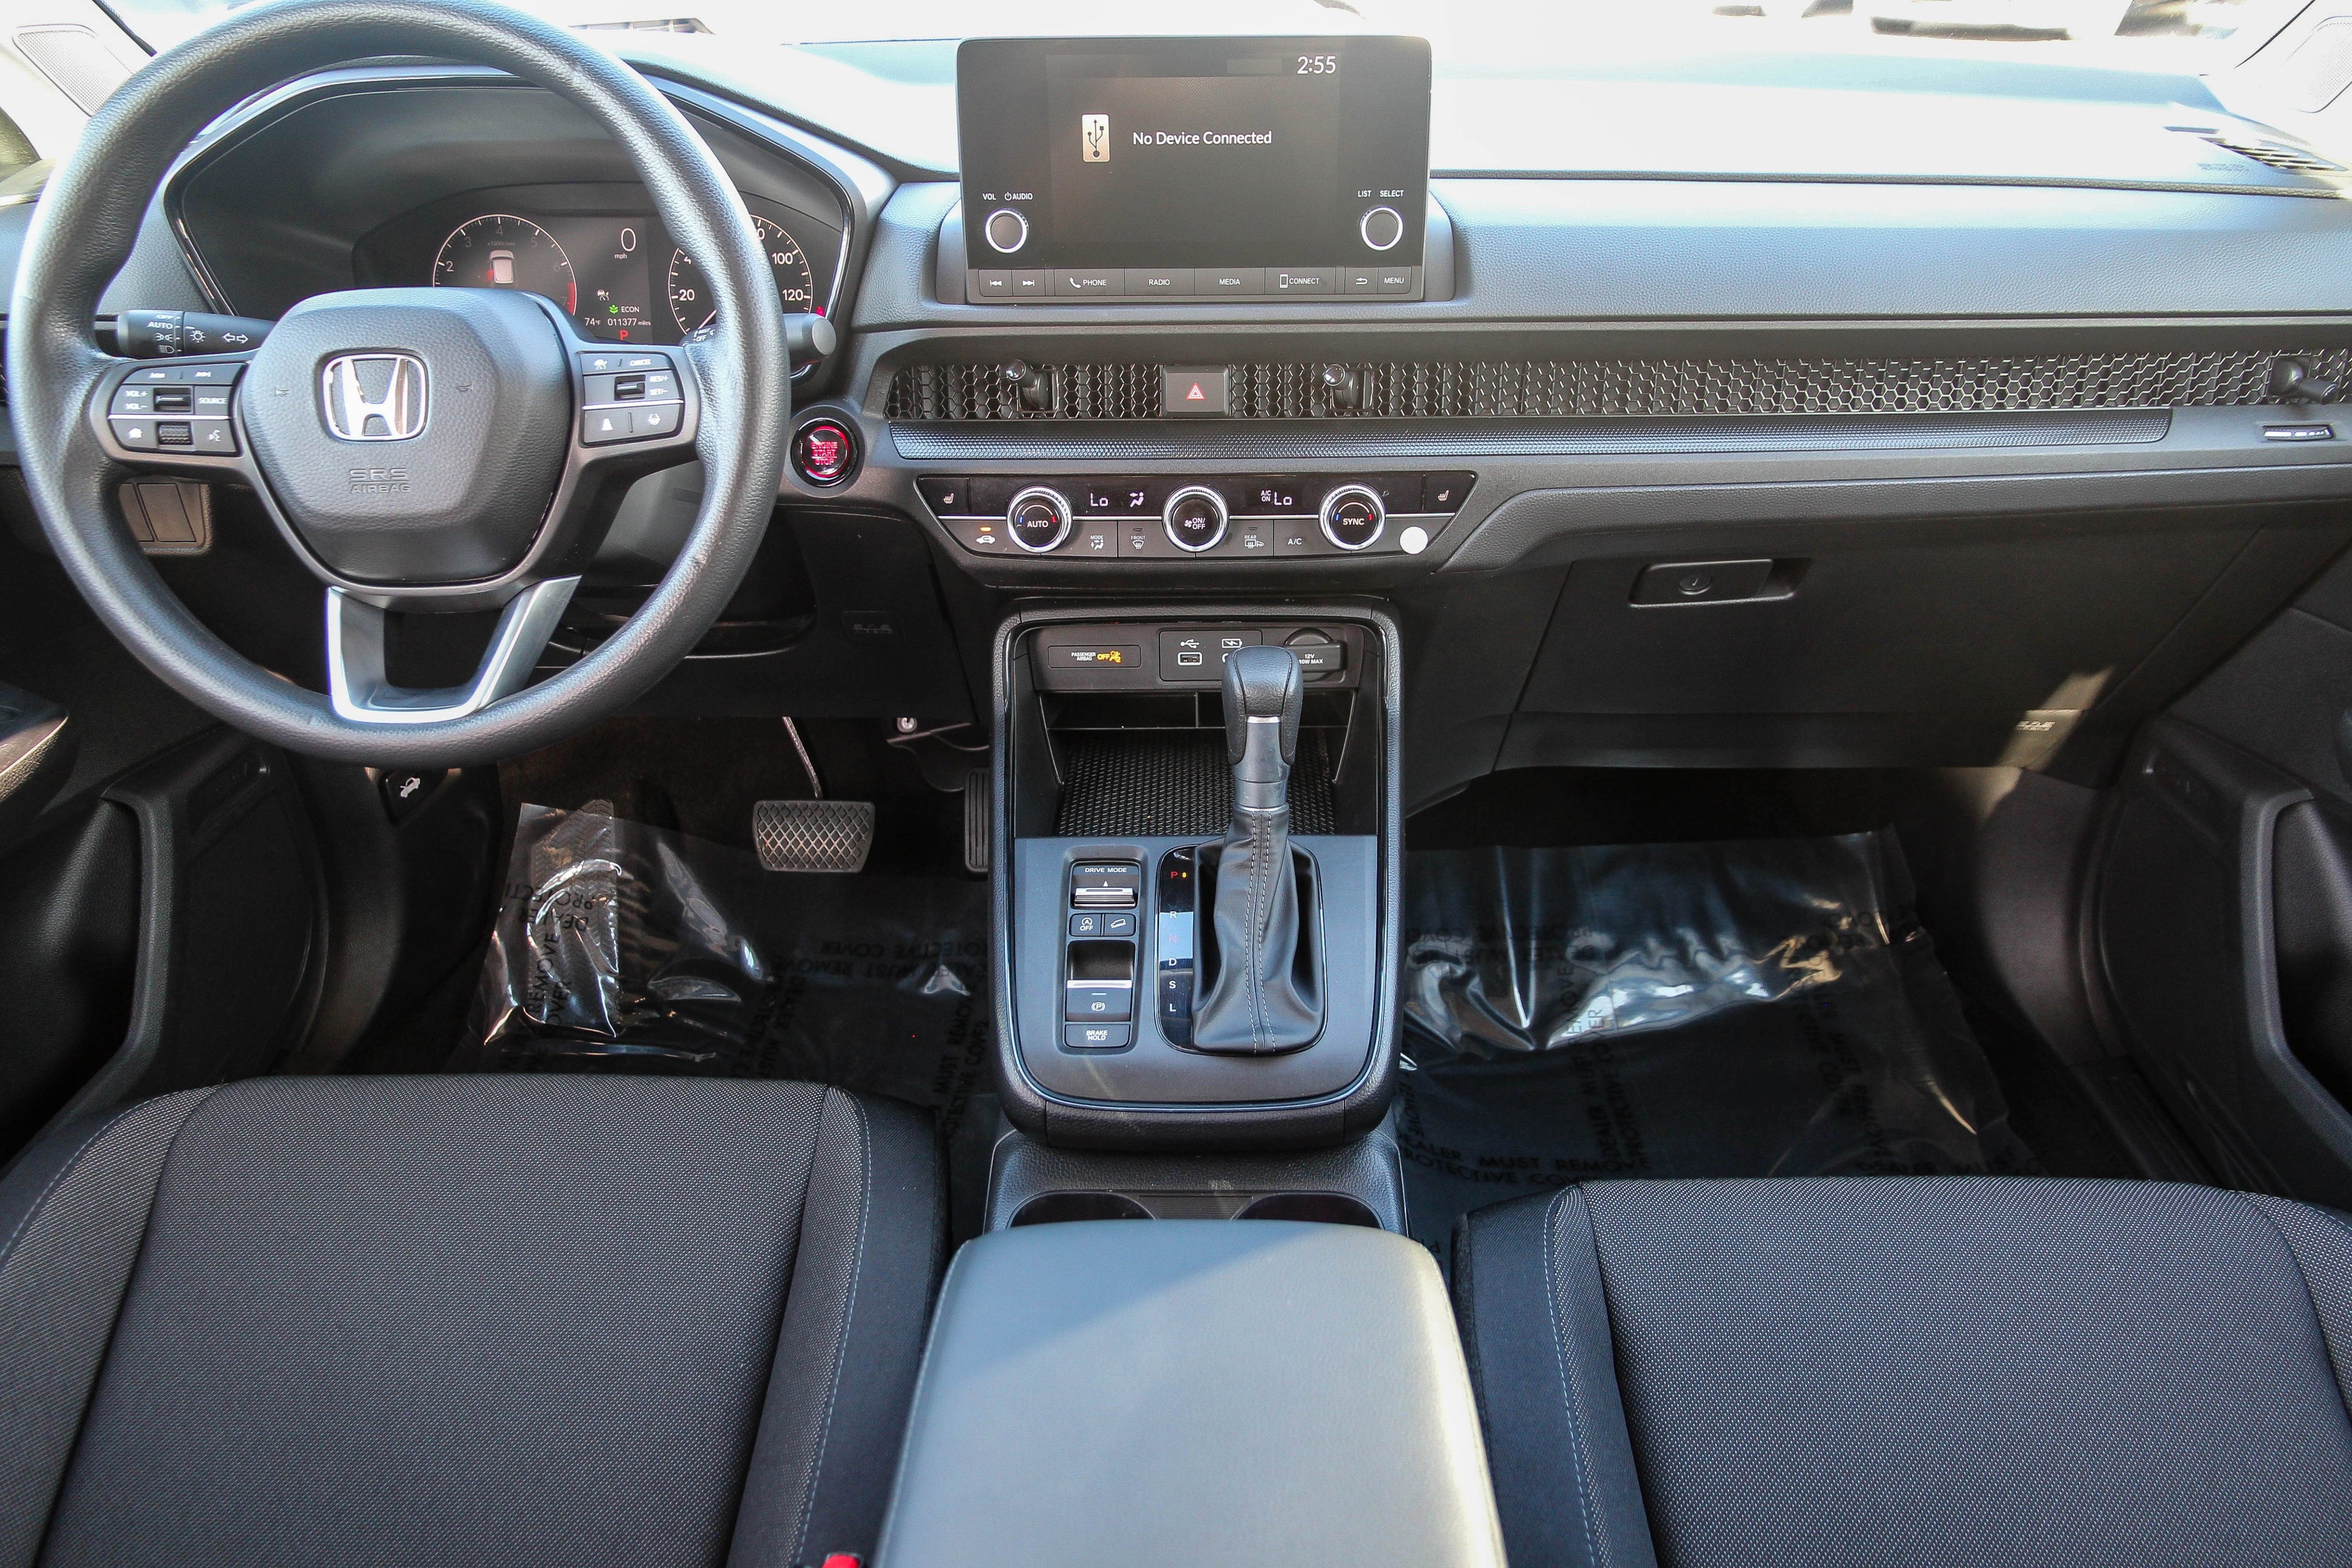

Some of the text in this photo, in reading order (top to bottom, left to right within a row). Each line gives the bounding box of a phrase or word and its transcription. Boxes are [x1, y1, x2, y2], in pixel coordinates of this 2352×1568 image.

[1296, 56, 1336, 75] 2:55
[1132, 131, 1272, 145] No Device Connected
[982, 192, 1033, 200] VOL AUDIO
[1357, 189, 1404, 198] LIST SELECT
[621, 227, 636, 252] 0
[771, 252, 793, 265] 100
[446, 261, 454, 271] 2
[1082, 279, 1107, 287] PHONE
[1148, 278, 1170, 287] RADIO
[1219, 278, 1241, 286] MEDIA
[1288, 277, 1320, 286] CONNECT
[1383, 276, 1405, 285] MENU
[679, 289, 695, 301] 20
[782, 289, 804, 301] 120
[607, 318, 637, 326] 011377
[619, 330, 629, 341] P
[349, 467, 409, 481] SRS
[350, 484, 411, 494] AIRBAG
[1026, 520, 1049, 528] AUTO
[1287, 537, 1303, 546] A/C
[1168, 980, 1176, 989] S
[1169, 1003, 1176, 1012] L
[1478, 1155, 1542, 1170] MUST
